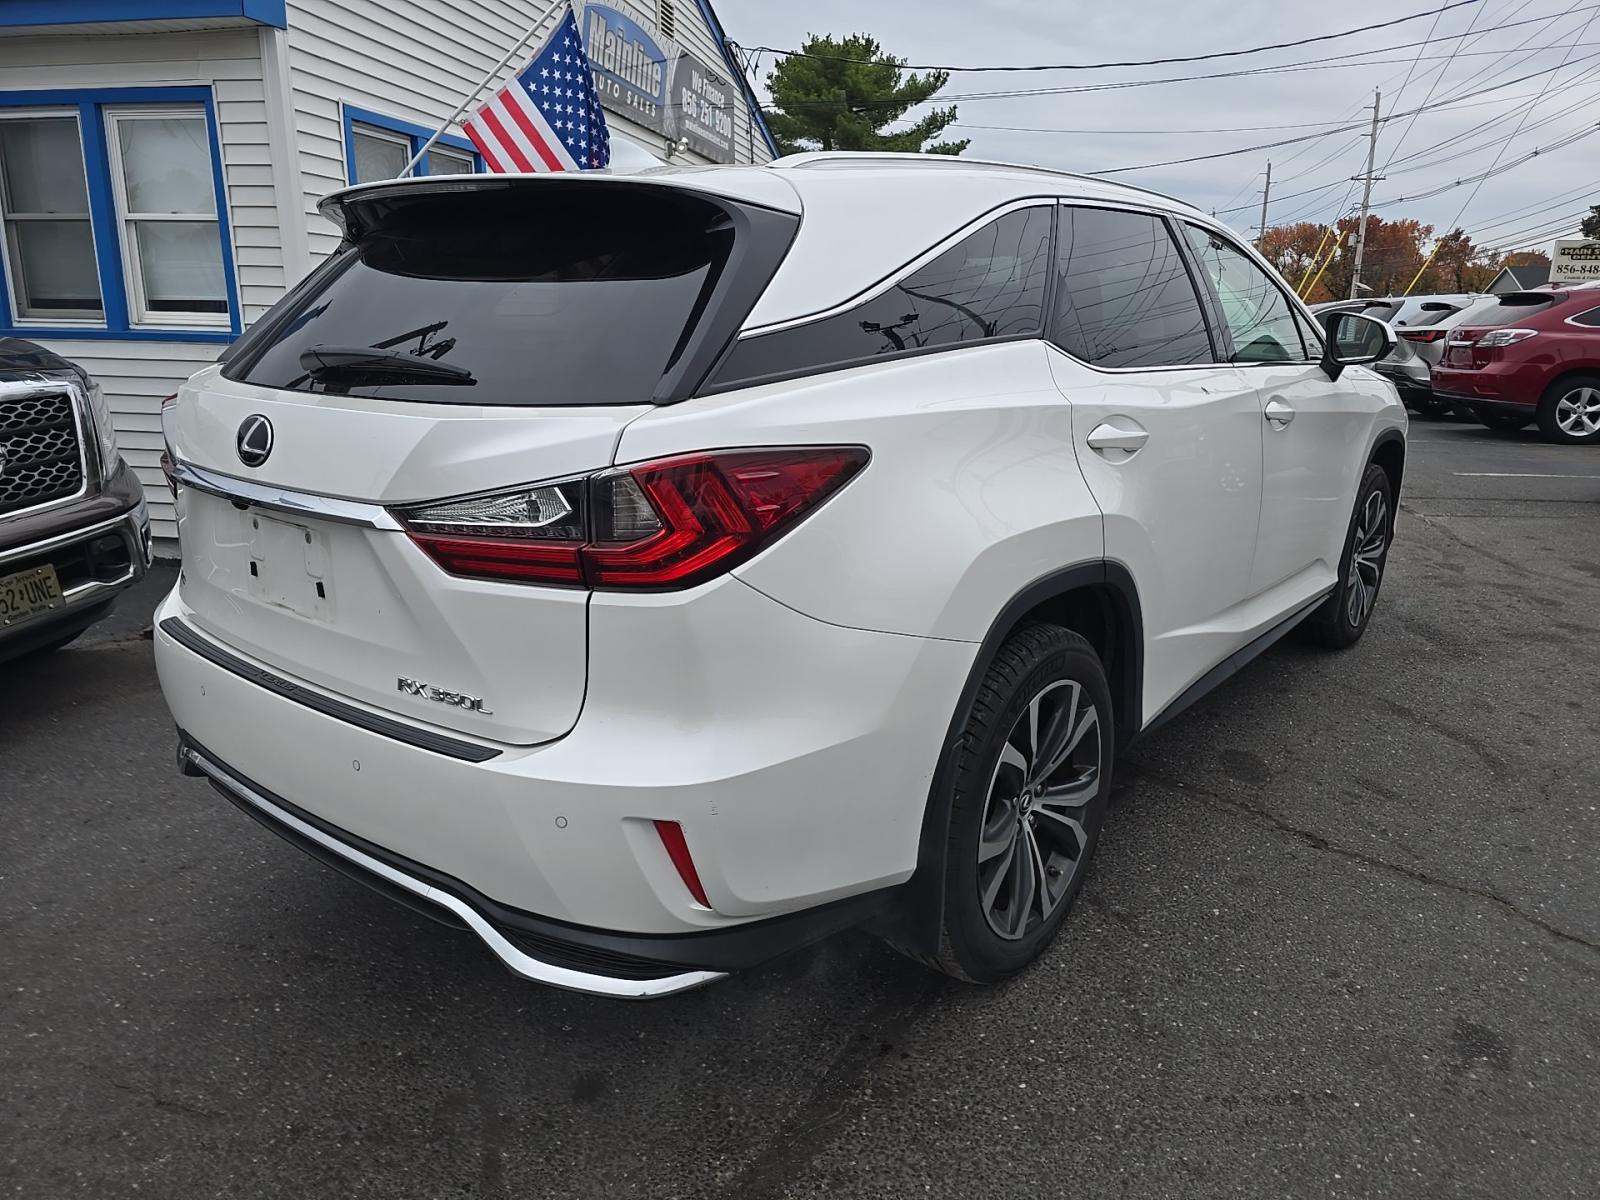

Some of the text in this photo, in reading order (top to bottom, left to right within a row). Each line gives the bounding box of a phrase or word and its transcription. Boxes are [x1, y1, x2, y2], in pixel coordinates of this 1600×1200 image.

[589, 10, 661, 98] Mainline
[627, 90, 656, 118] SALES
[398, 677, 493, 715] RX 350L
